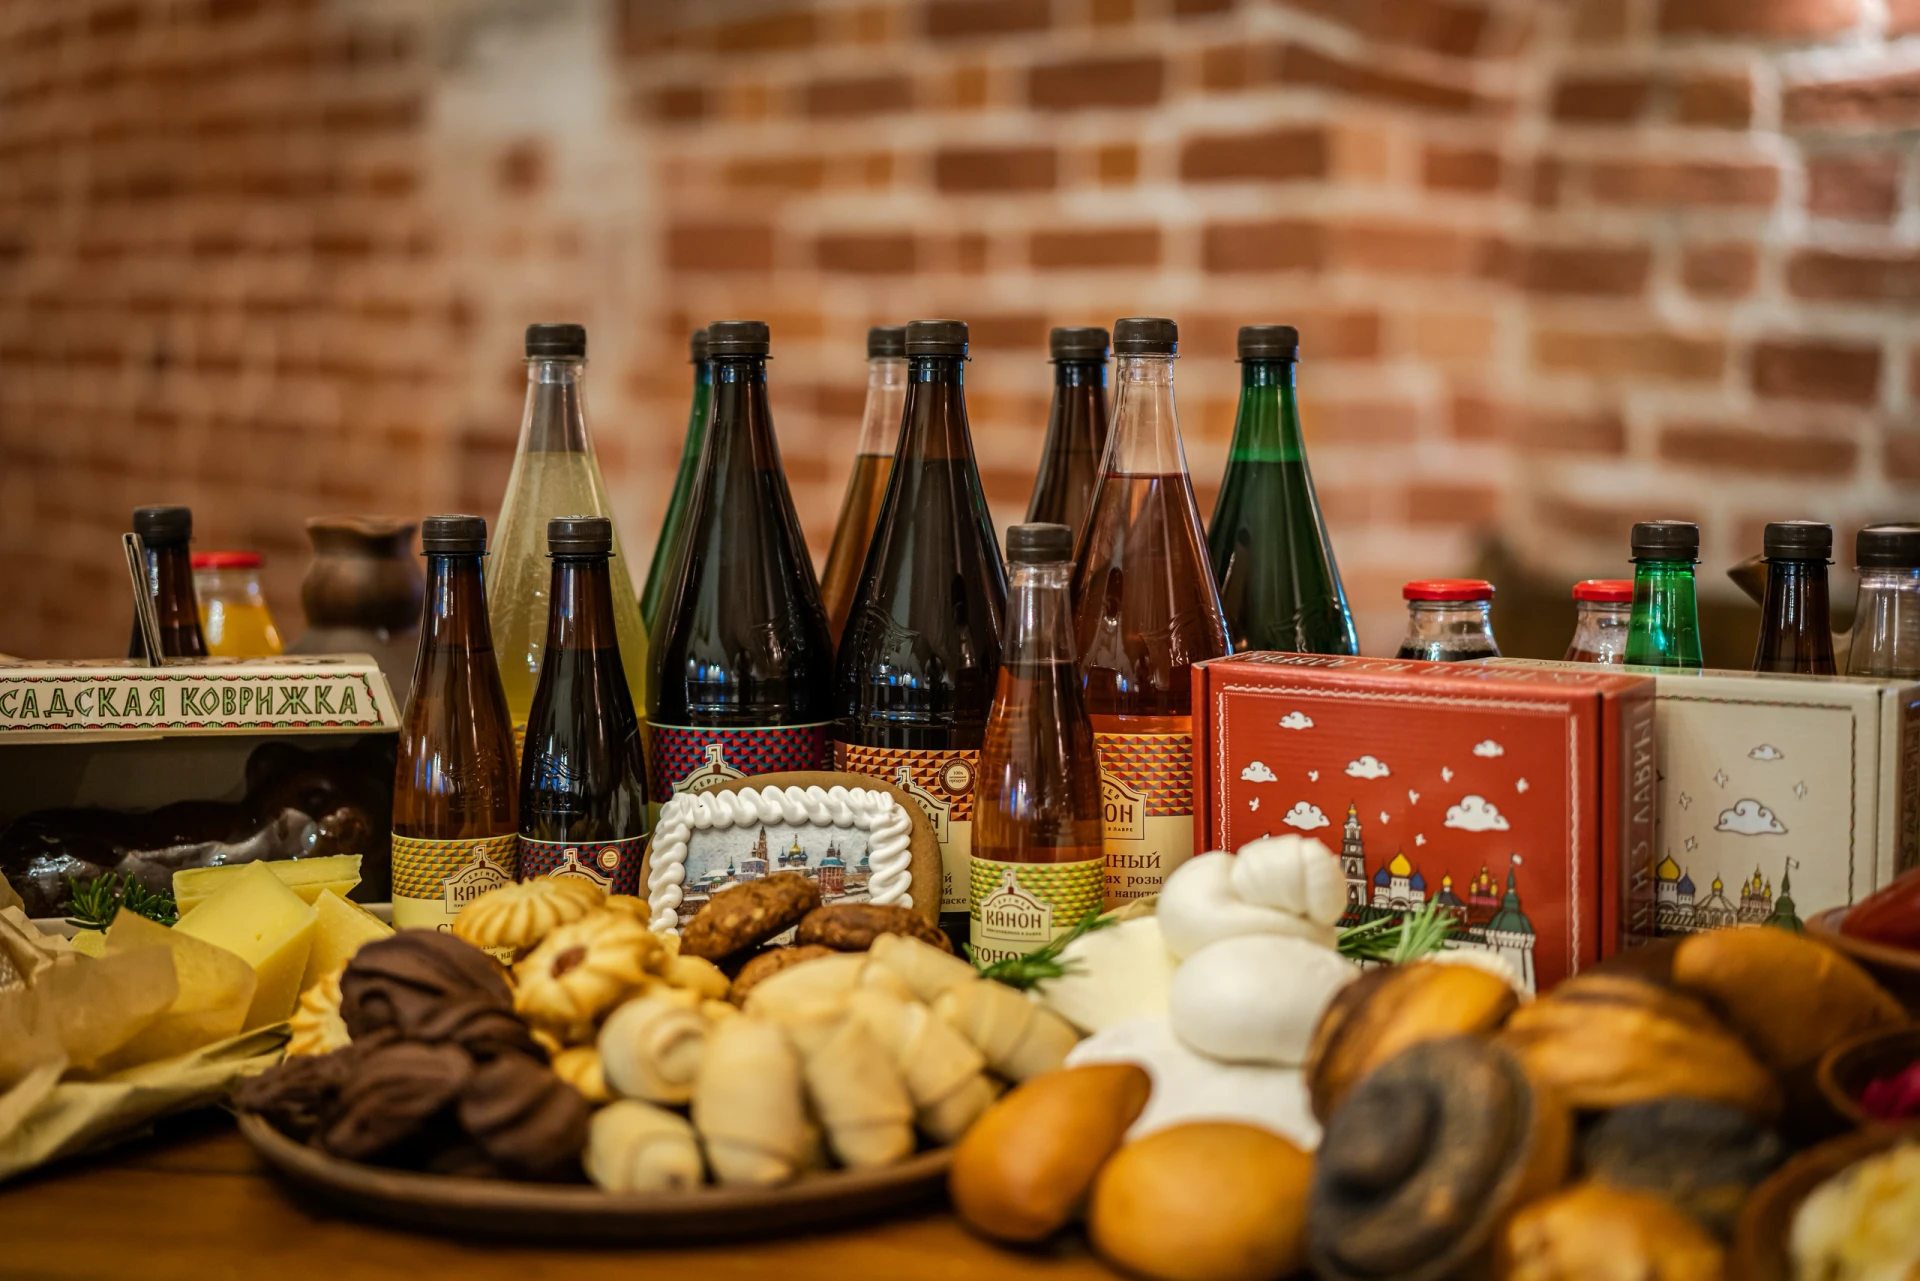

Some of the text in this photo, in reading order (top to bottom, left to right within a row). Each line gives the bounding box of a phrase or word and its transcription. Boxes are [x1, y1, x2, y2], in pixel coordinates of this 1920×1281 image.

[0, 685, 357, 718] САДСКАЯ КОВРИЖКА
[463, 871, 500, 884] СЕРГИЕВ
[1127, 875, 1162, 887] розы
[993, 897, 1031, 910] СЕРГИЕВ
[986, 910, 1041, 928] КАНОН
